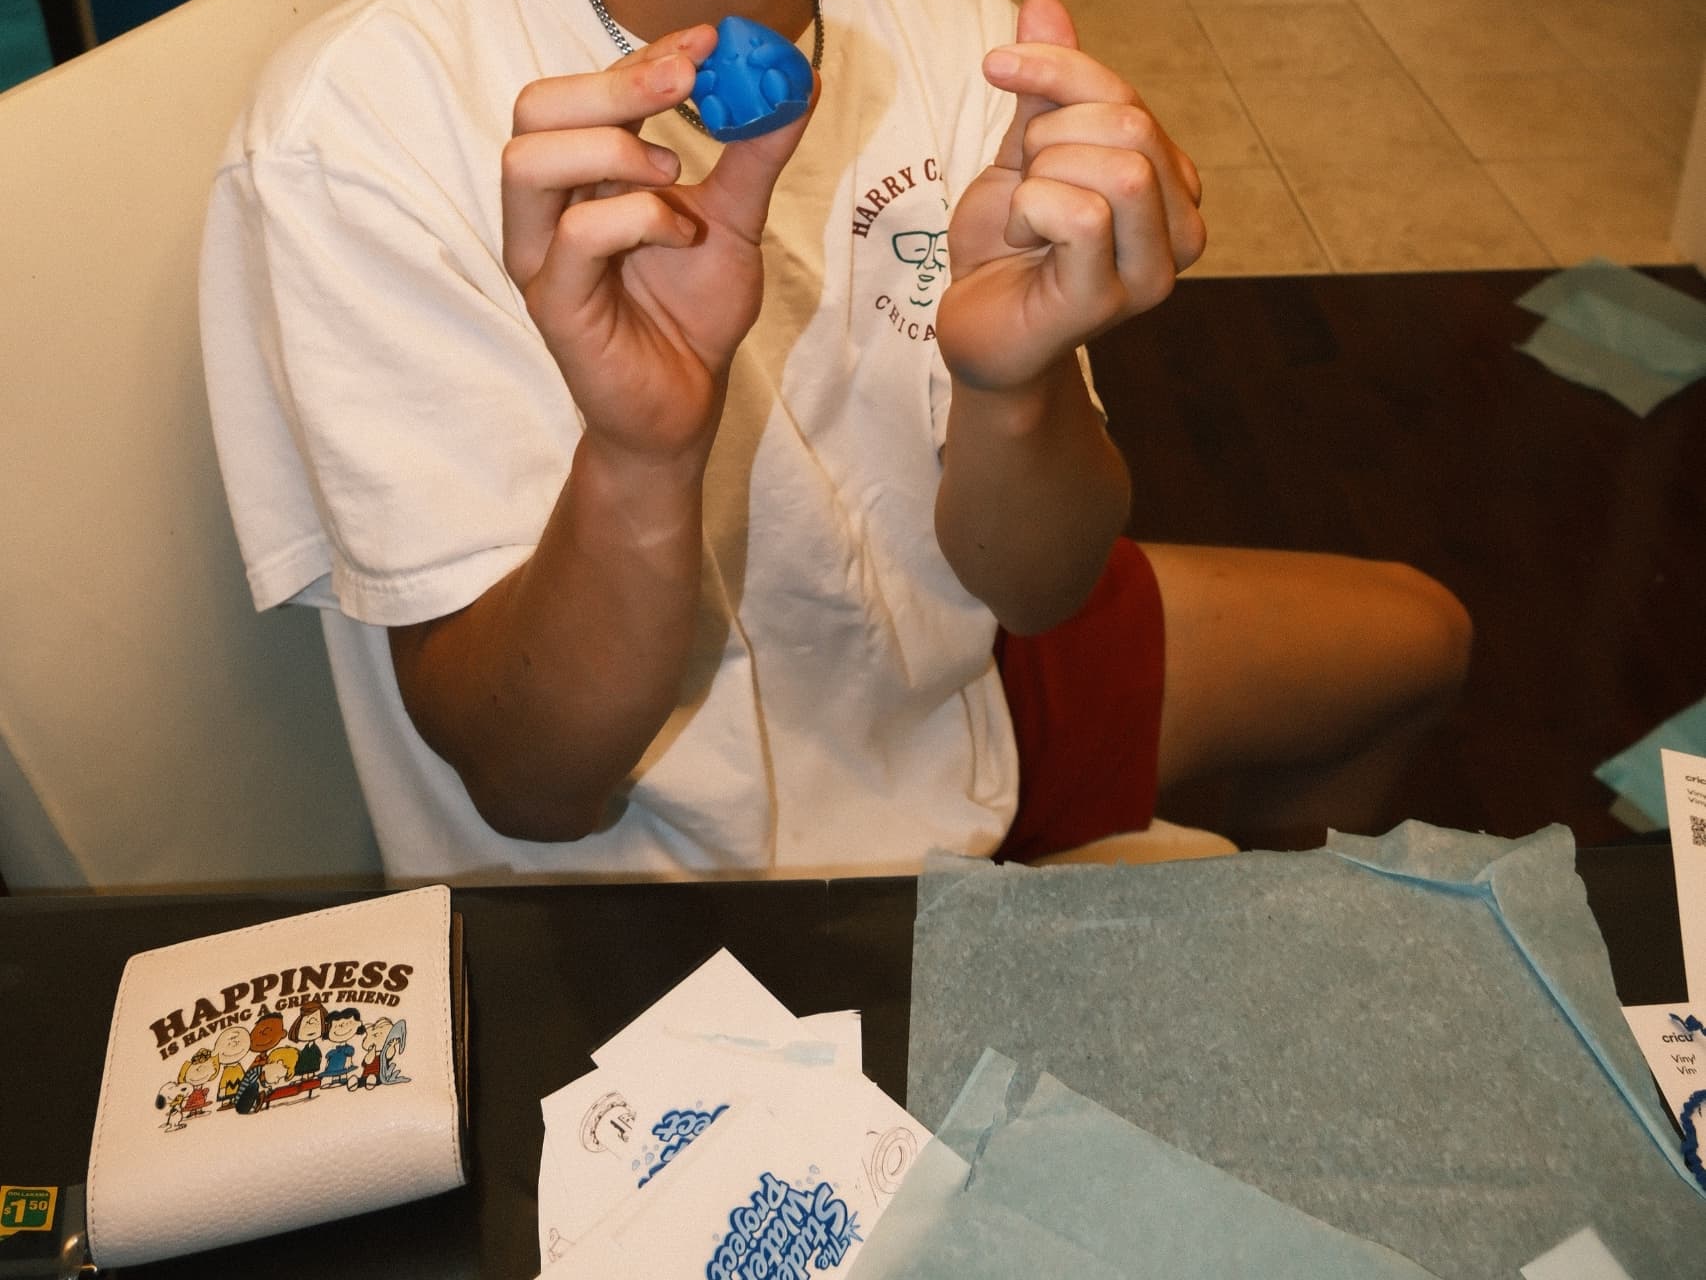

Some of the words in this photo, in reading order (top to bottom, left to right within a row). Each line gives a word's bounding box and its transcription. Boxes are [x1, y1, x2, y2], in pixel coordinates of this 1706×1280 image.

[852, 166, 917, 239] HARRY
[149, 960, 414, 1048] HAPPINESS
[159, 1041, 180, 1061] IS
[182, 1008, 253, 1048] HAVING
[257, 1003, 271, 1017] A
[275, 991, 334, 1011] GREAT
[335, 989, 401, 1008] FRIEND
[814, 1234, 850, 1270] The
